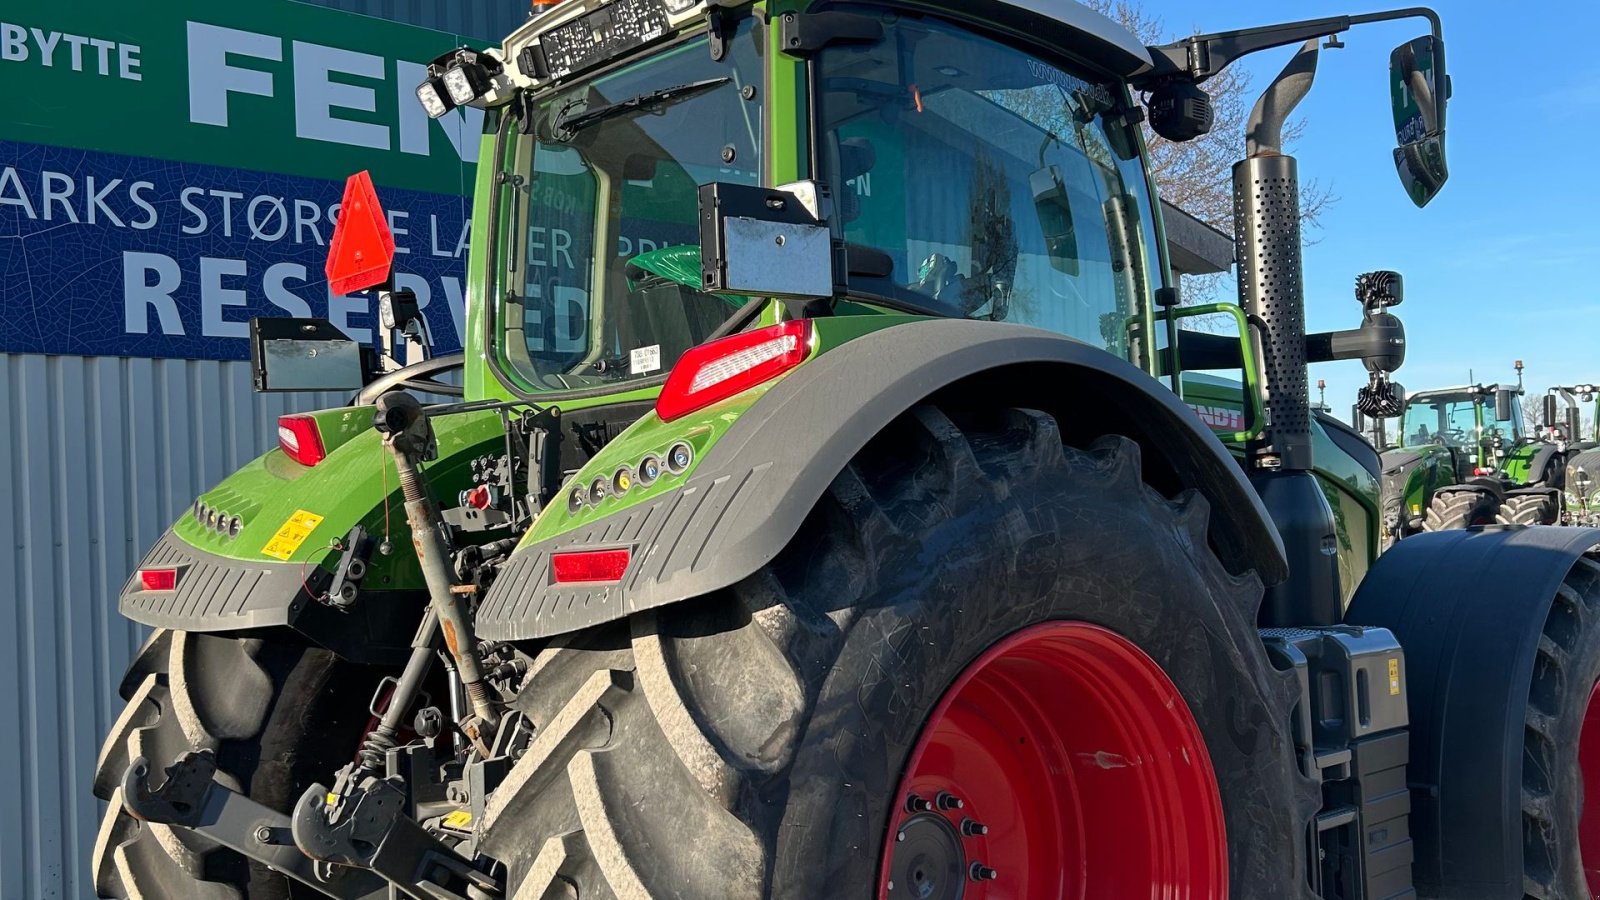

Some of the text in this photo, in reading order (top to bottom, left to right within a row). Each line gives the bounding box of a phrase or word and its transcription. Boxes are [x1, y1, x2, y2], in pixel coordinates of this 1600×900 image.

[1, 22, 143, 81] BYTTE
[180, 187, 411, 255] STØRE
[1186, 404, 1242, 428] NDT
